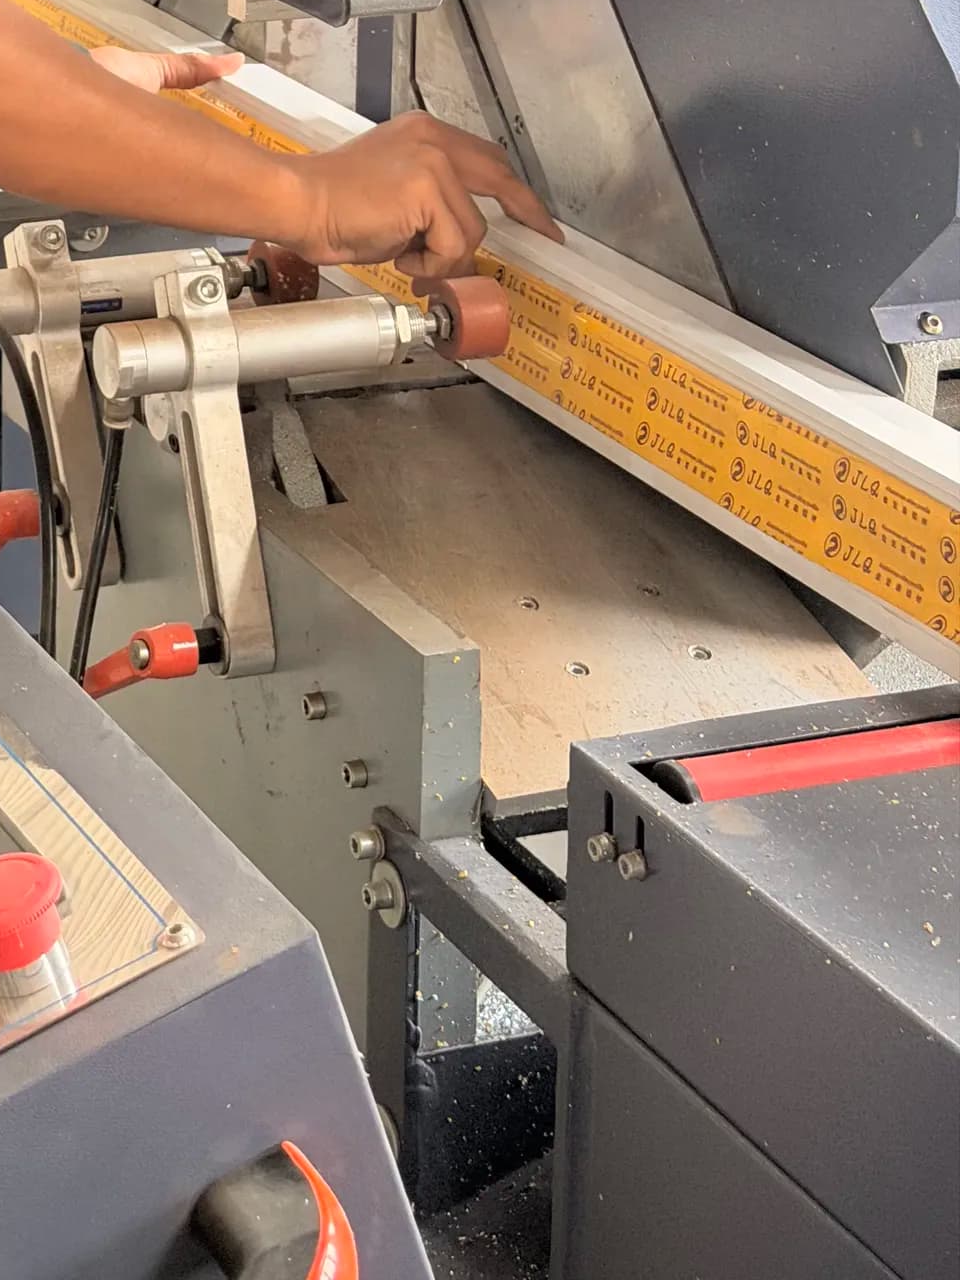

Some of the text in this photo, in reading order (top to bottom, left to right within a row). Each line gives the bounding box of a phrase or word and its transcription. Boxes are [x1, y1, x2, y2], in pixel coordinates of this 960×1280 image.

[663, 364, 687, 389] JLQ
[661, 398, 684, 424] JLQ
[650, 433, 676, 458] JLQ
[752, 432, 777, 459] JLQ
[746, 469, 772, 496] JLQ
[851, 470, 880, 498] JLQ
[850, 508, 877, 536] JLQ
[842, 545, 873, 574] JLQ
